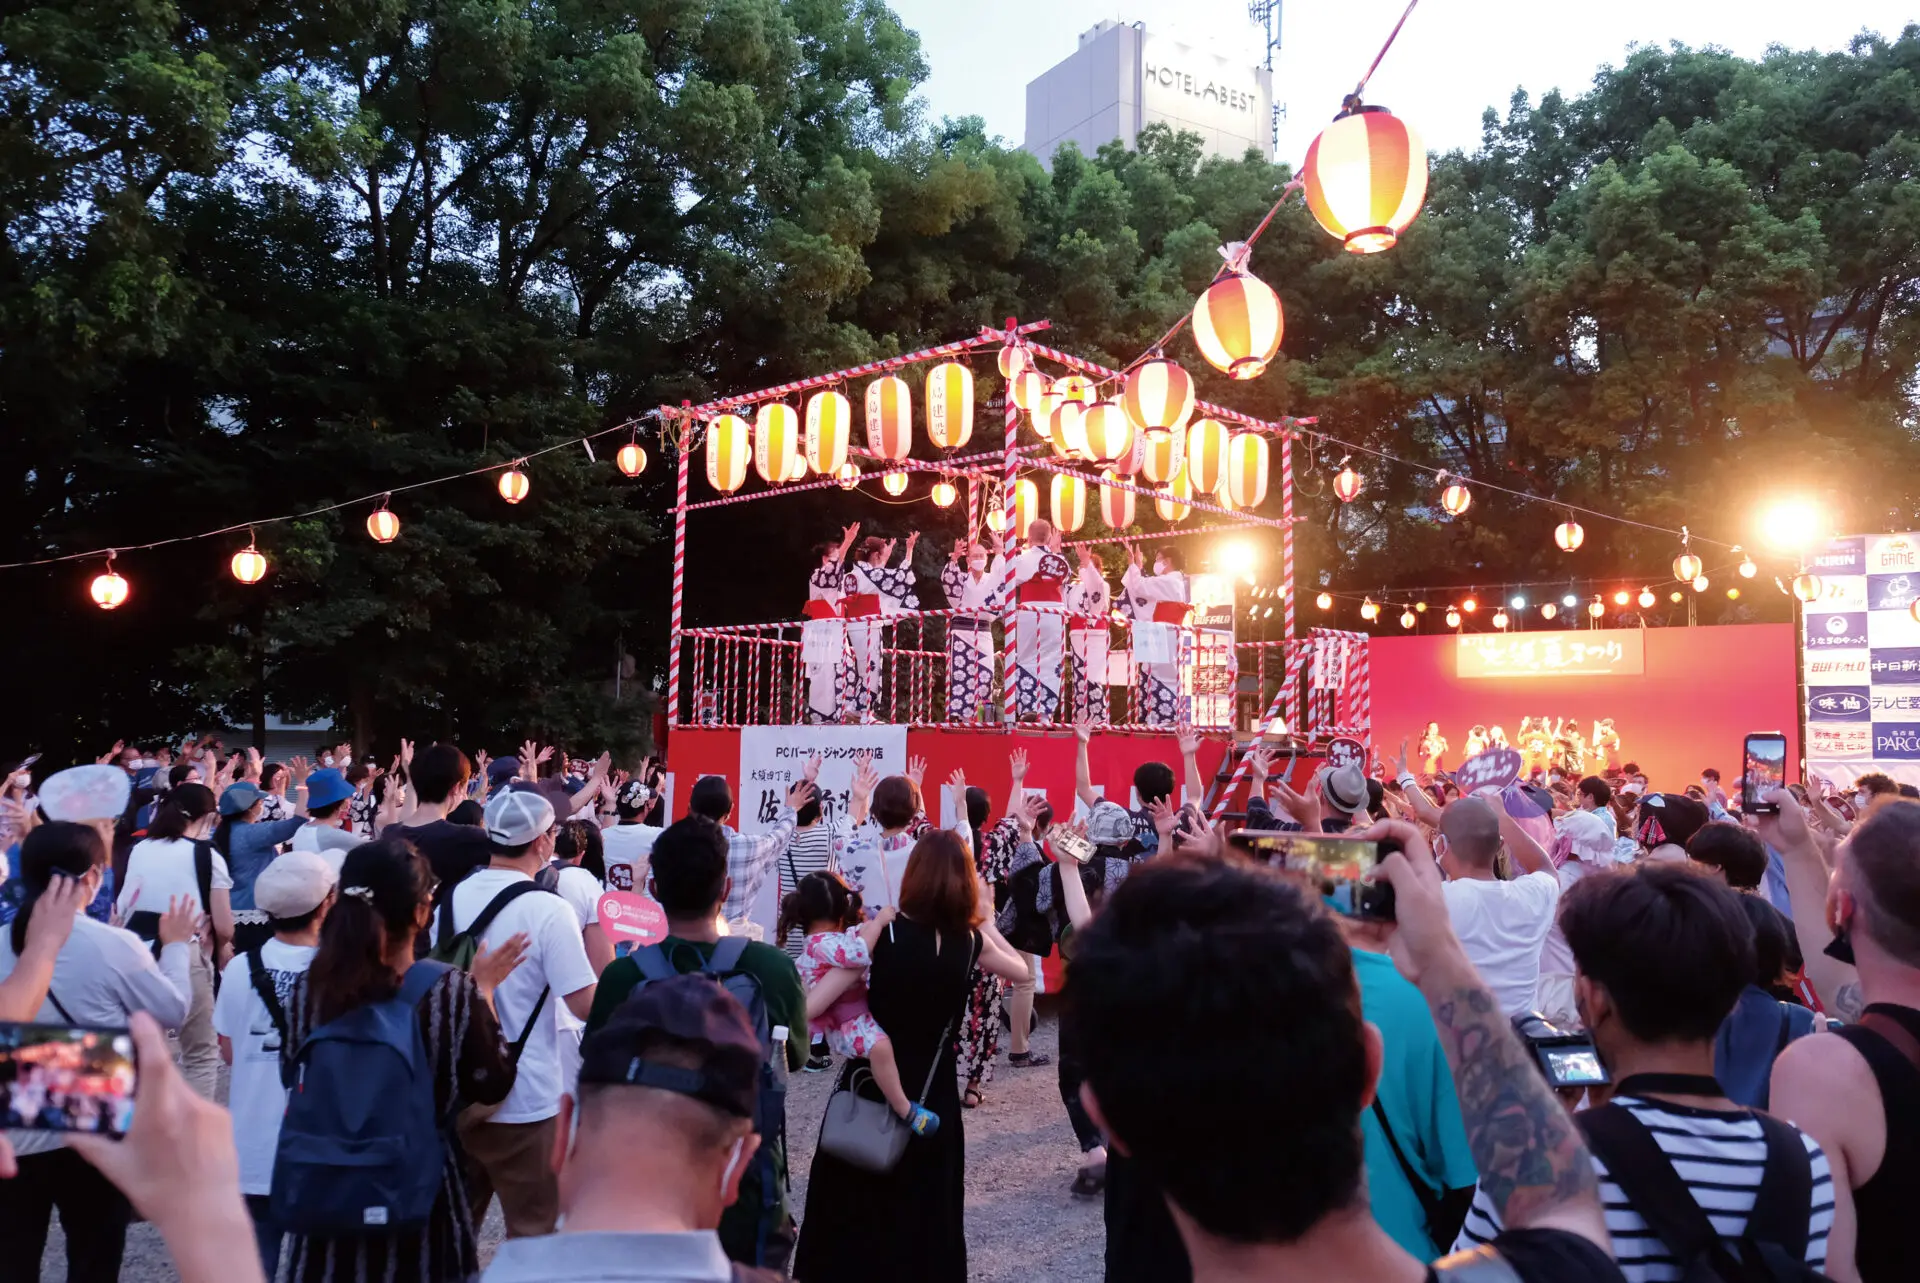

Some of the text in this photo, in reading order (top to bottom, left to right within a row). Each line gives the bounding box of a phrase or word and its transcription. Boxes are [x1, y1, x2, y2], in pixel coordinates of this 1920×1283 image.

[1815, 554, 1855, 567] KIRIN
[1881, 551, 1915, 567] GAME
[1811, 661, 1866, 673] BUFFALO
[1871, 659, 1920, 673] 中日新
